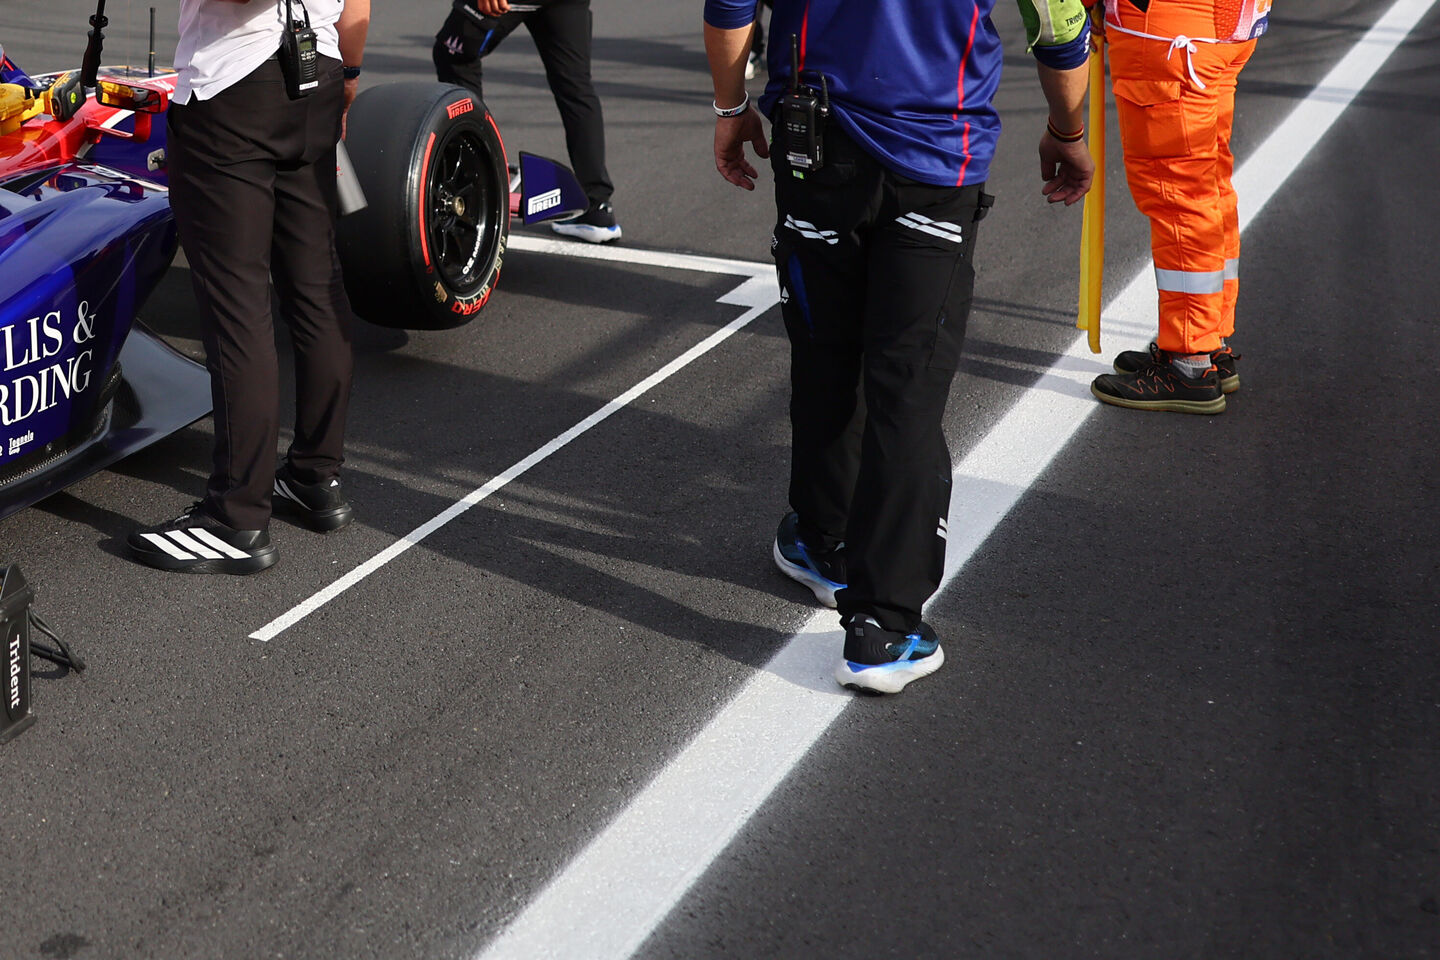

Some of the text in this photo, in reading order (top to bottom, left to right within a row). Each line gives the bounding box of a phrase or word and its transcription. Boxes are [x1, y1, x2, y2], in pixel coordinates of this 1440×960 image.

[446, 98, 474, 119] PIRELLI
[527, 189, 561, 216] PIRELLI
[72, 300, 98, 345] &
[9, 634, 21, 709] Trident
